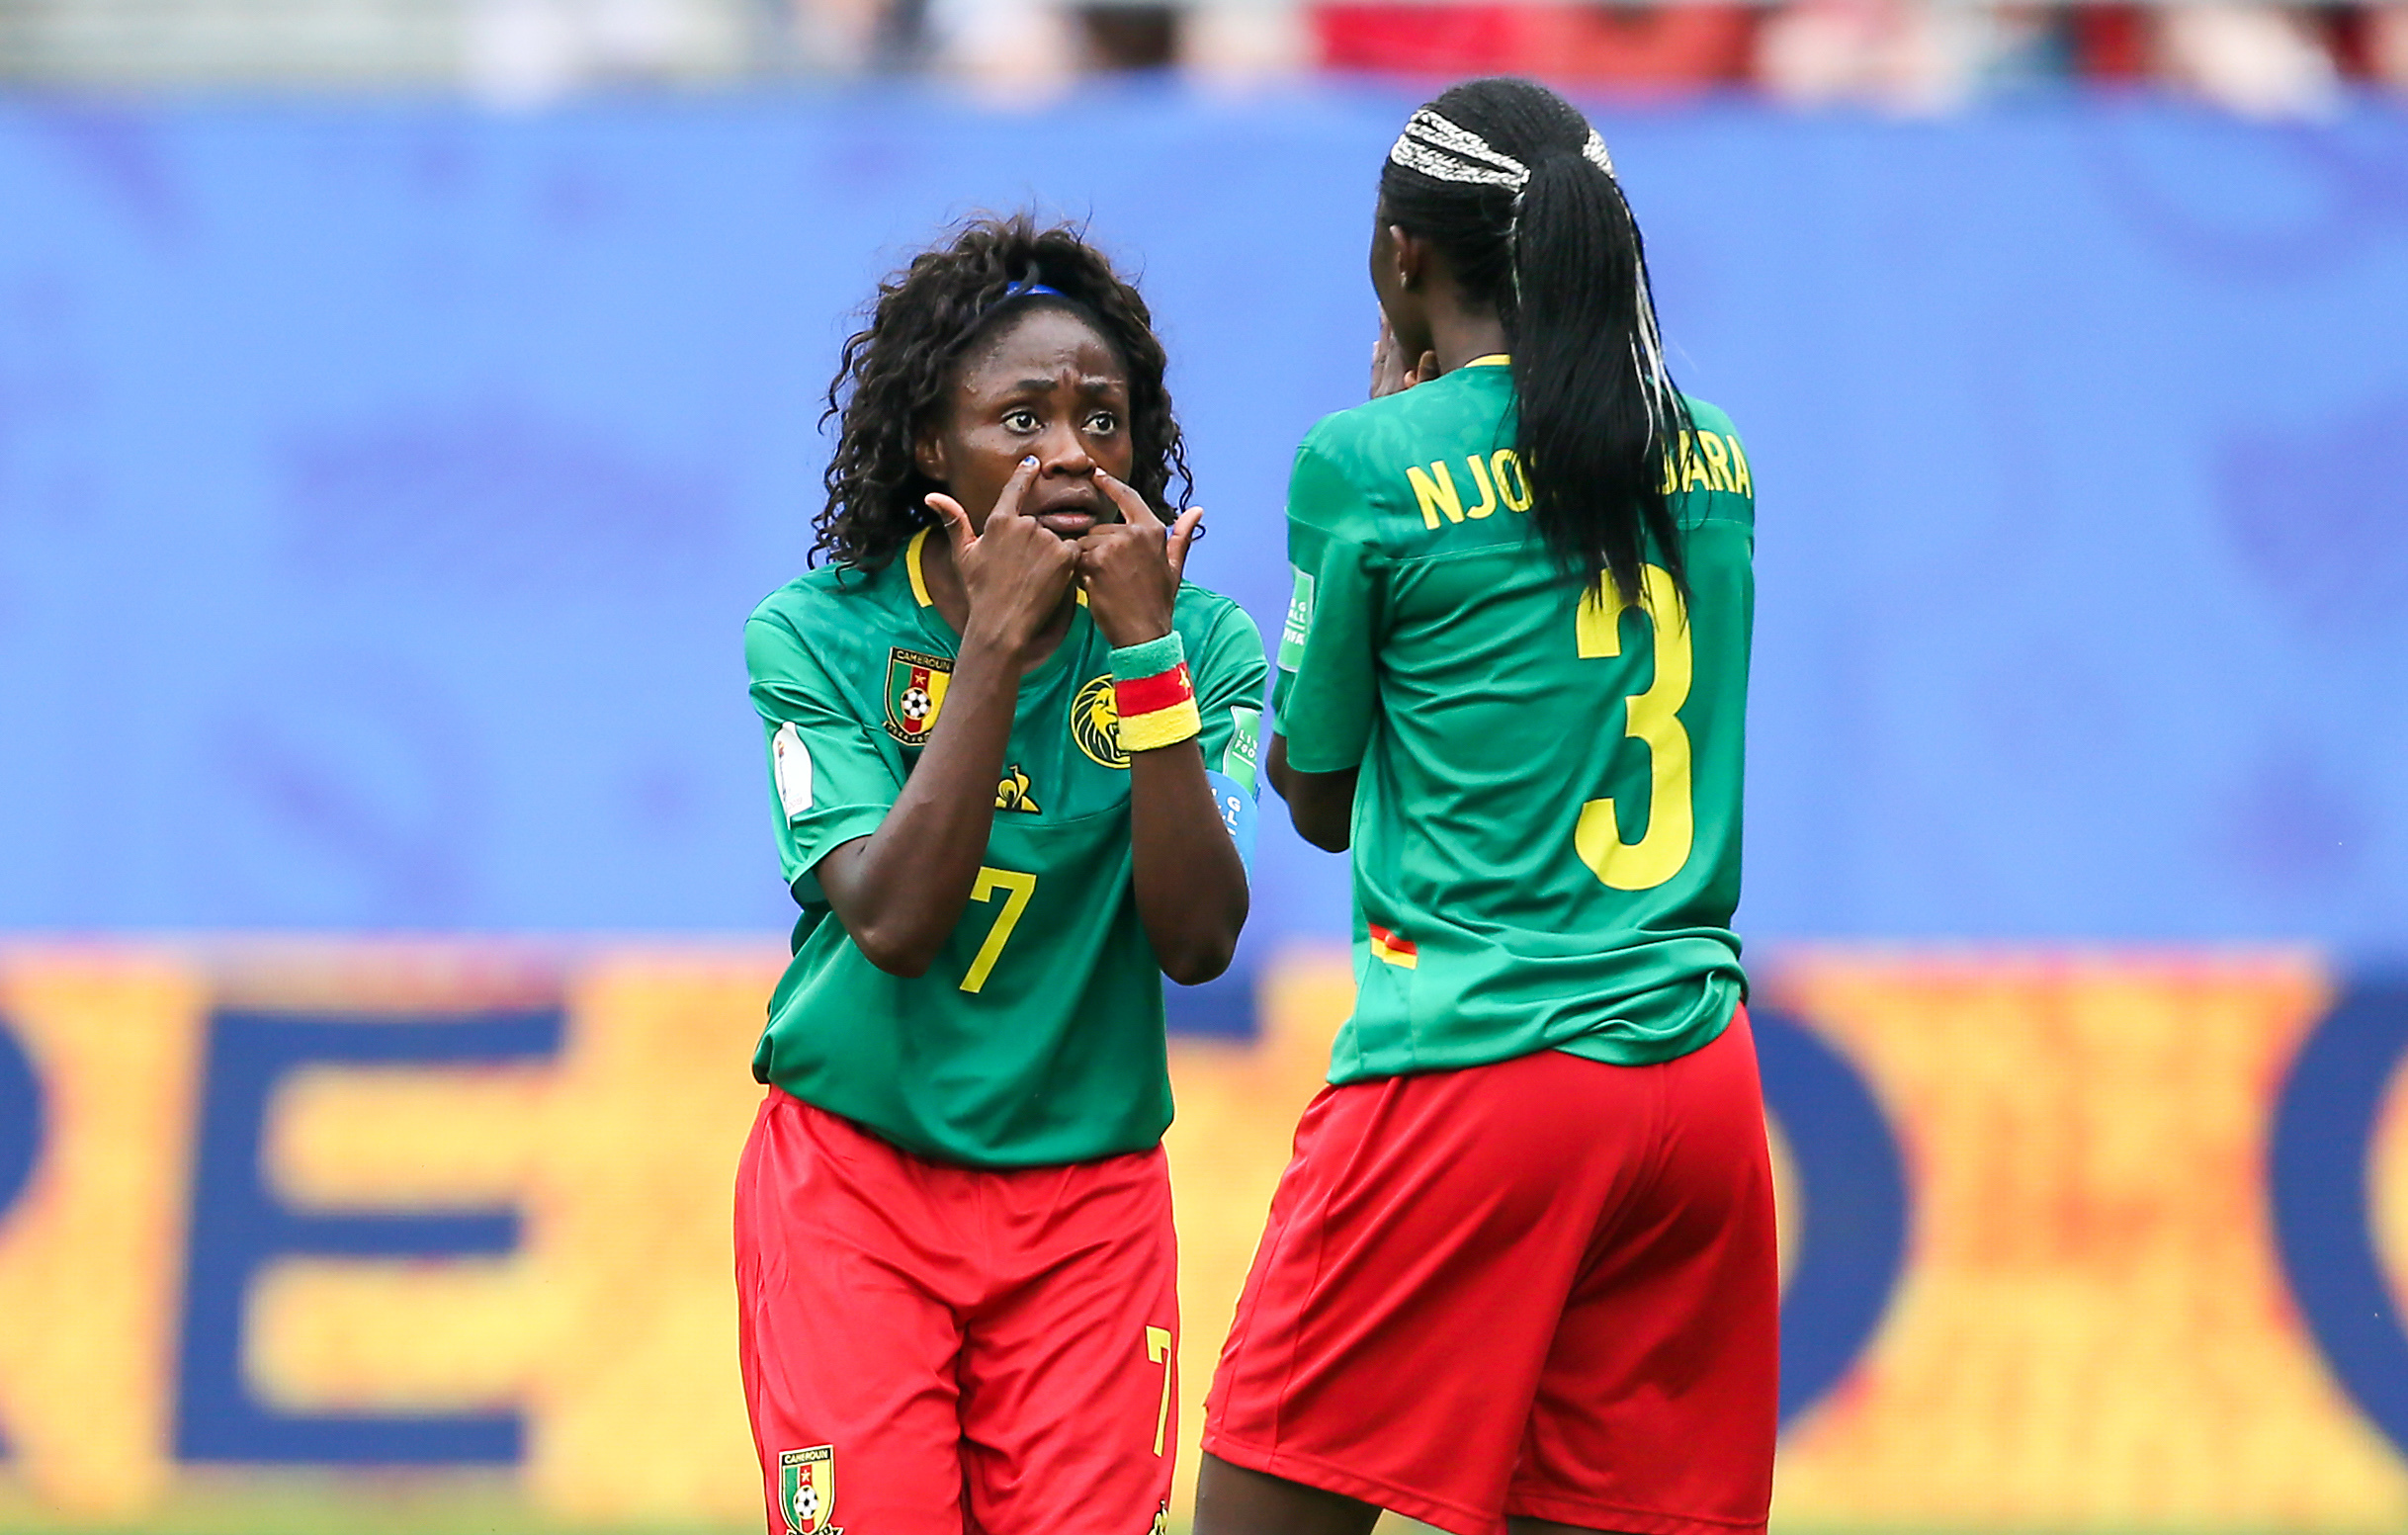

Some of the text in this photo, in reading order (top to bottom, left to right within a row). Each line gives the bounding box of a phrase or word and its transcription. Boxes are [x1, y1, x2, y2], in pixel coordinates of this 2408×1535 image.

[897, 650, 950, 670] CAMEROUN
[1575, 562, 1693, 891] 3
[959, 866, 1037, 993] 7
[1146, 1325, 1171, 1457] 7
[785, 1449, 828, 1464] CAMEROUN
